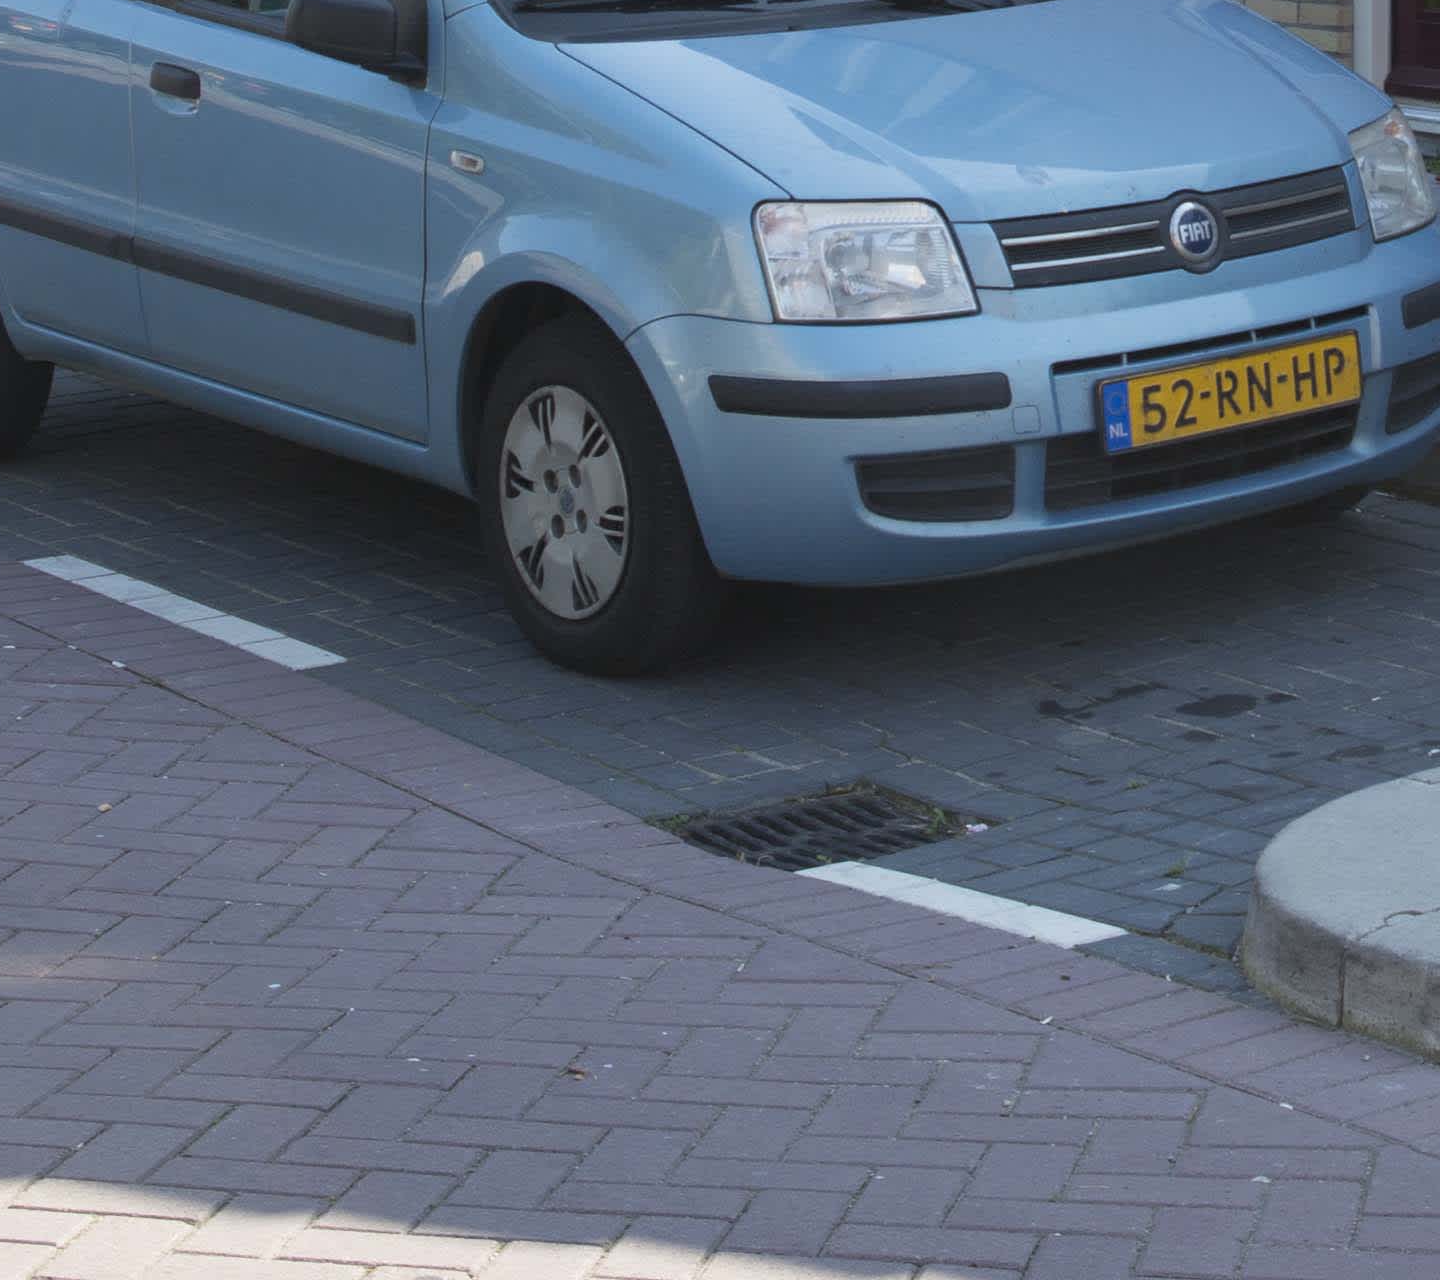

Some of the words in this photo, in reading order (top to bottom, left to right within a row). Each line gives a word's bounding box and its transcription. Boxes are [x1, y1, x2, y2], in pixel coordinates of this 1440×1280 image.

[1179, 220, 1212, 244] FIAT
[1140, 346, 1346, 435] 52-RN-HP
[1109, 422, 1129, 439] NL
